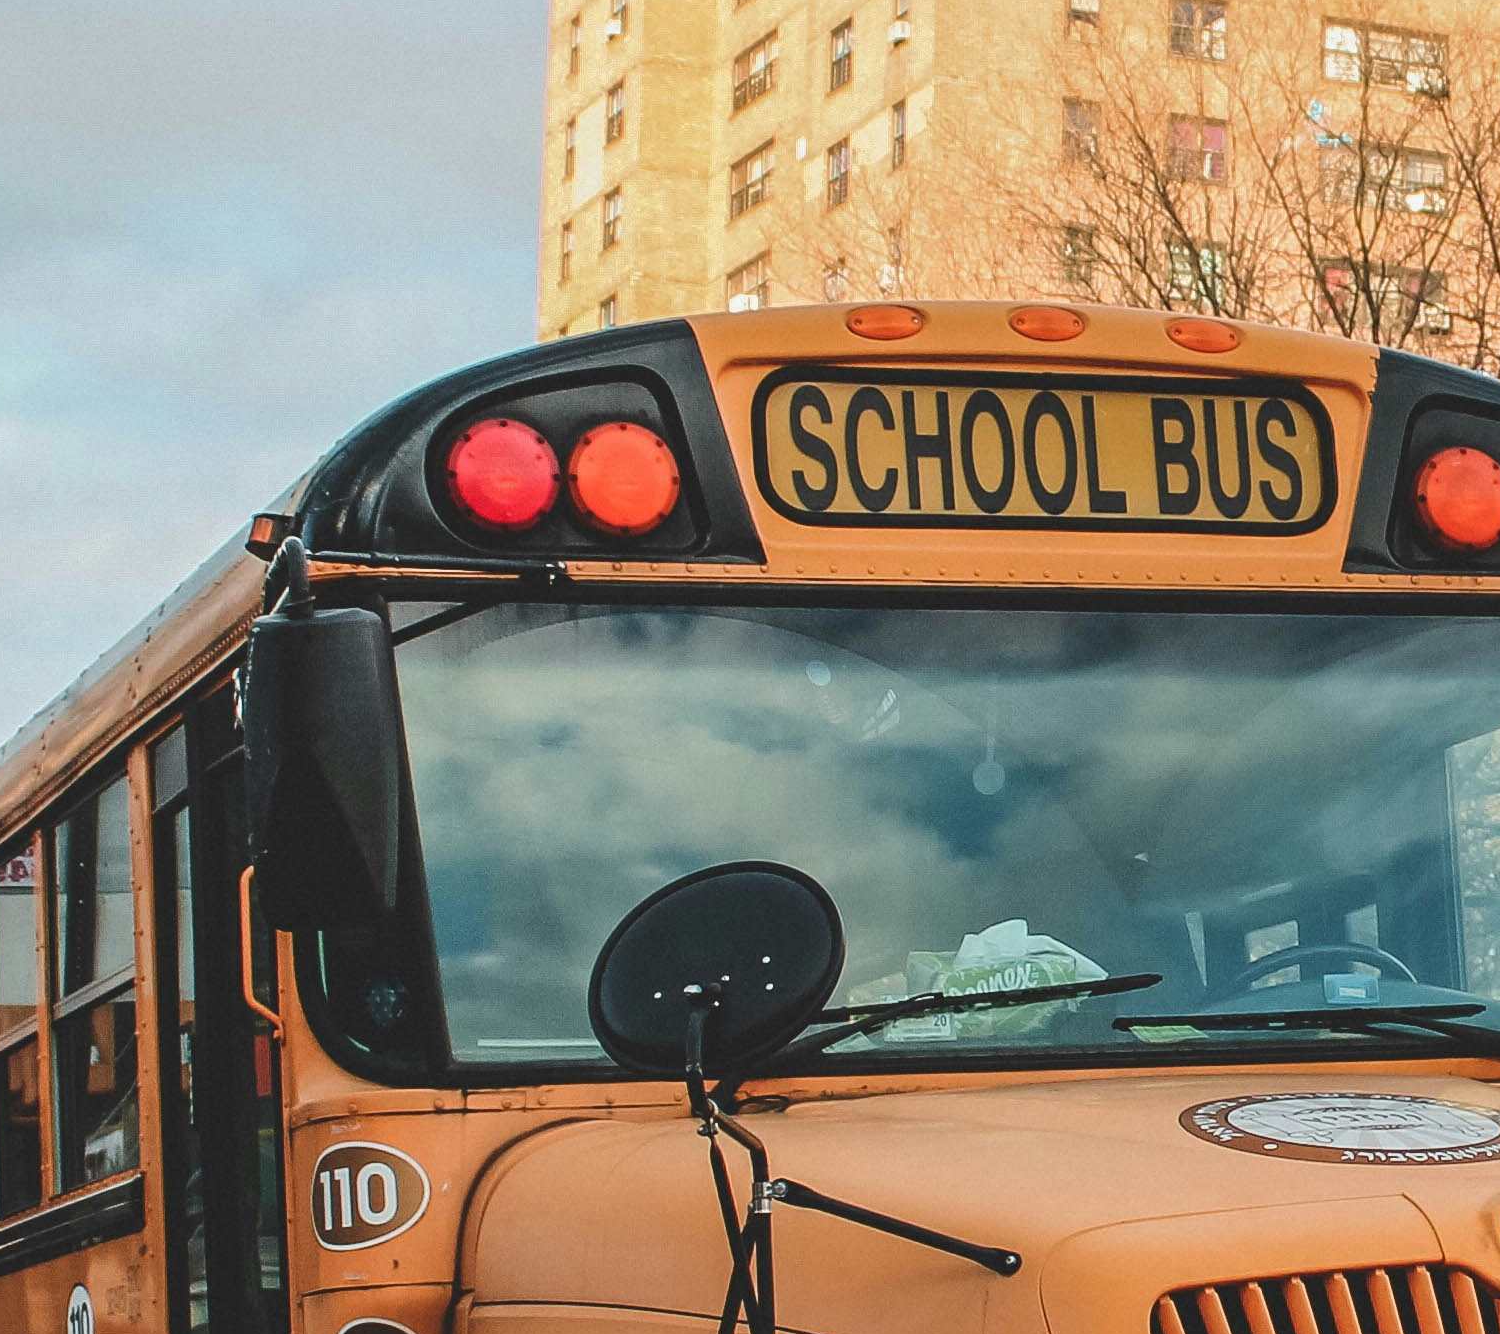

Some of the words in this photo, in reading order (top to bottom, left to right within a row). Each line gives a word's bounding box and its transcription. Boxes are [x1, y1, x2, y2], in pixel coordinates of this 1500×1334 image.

[789, 384, 1127, 515] SCHOOL
[1150, 397, 1301, 522] BUS
[948, 964, 1038, 998] enex
[320, 1162, 398, 1231] 110
